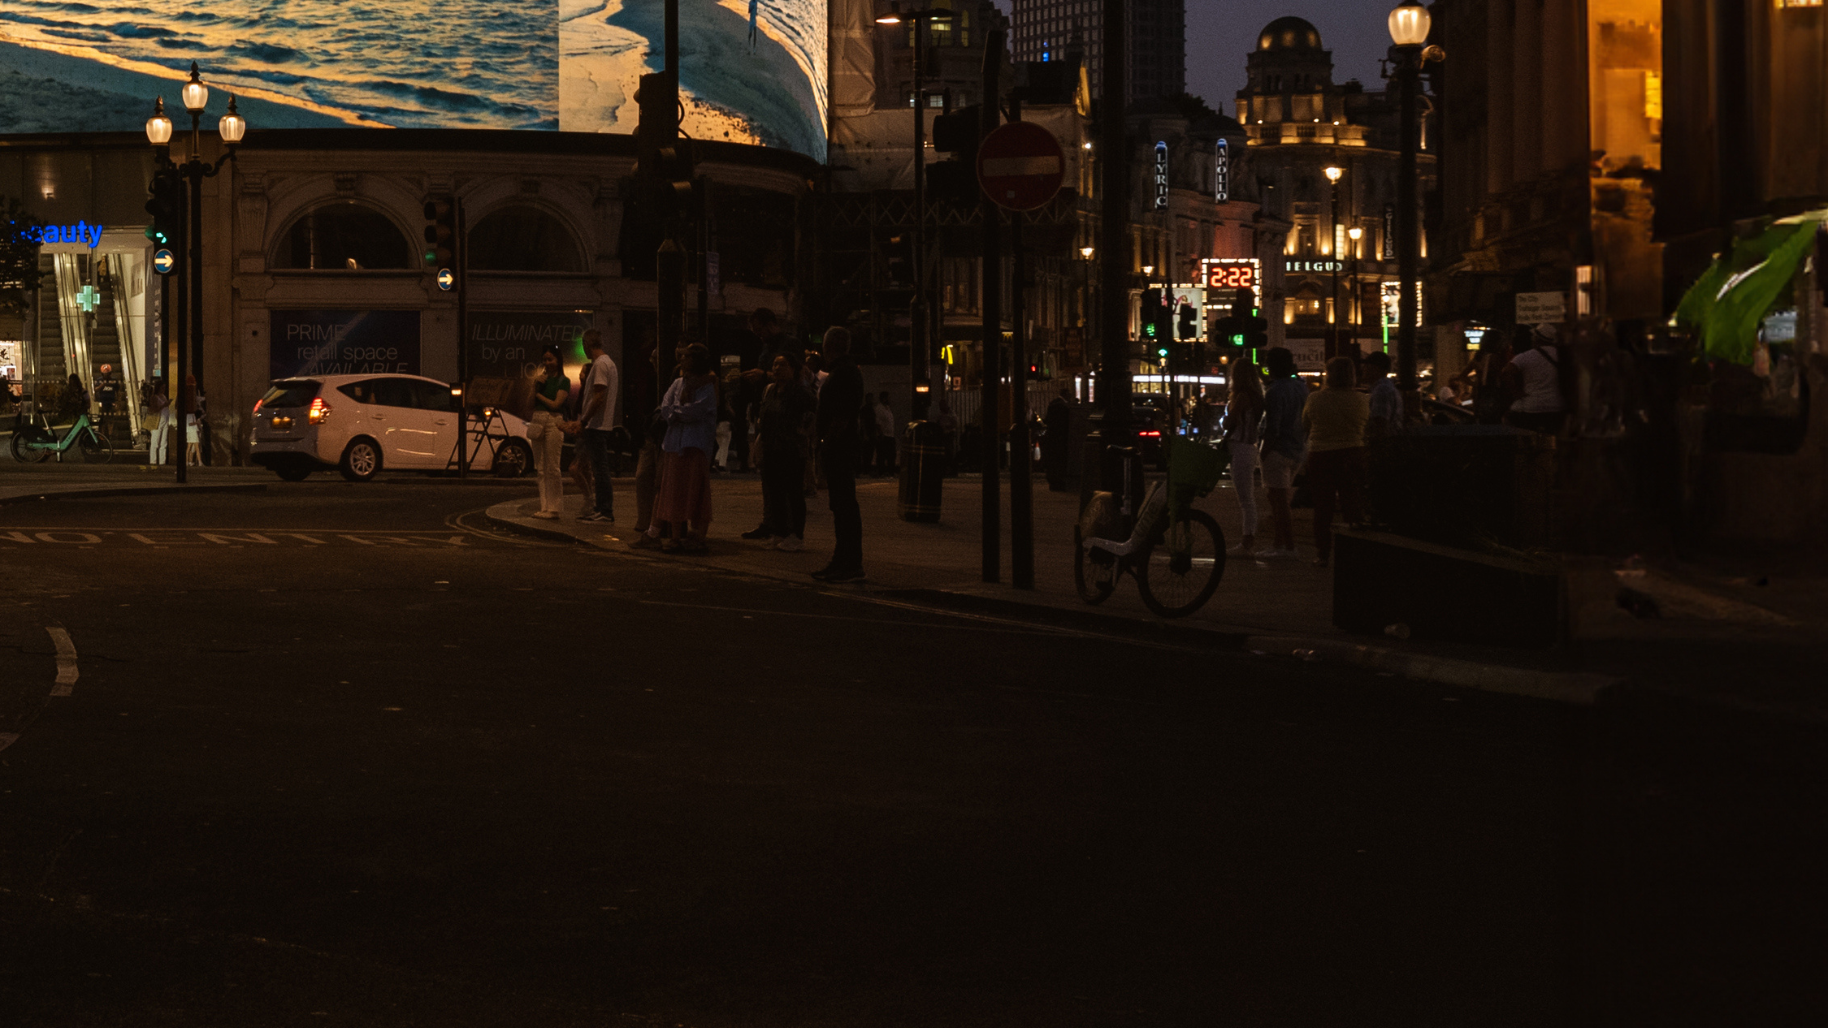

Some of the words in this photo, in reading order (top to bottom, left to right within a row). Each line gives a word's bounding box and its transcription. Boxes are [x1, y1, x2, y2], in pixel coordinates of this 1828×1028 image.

[1156, 153, 1167, 207] LYRIC
[1217, 148, 1228, 201] APOLLO
[1209, 266, 1253, 288] 2:22
[286, 324, 346, 341] PRIME
[472, 324, 584, 342] ILLUMINATED
[297, 343, 338, 360] retail
[343, 346, 398, 363] space
[482, 343, 501, 363] by
[505, 347, 525, 360] an
[133, 529, 472, 547] ENTRY
